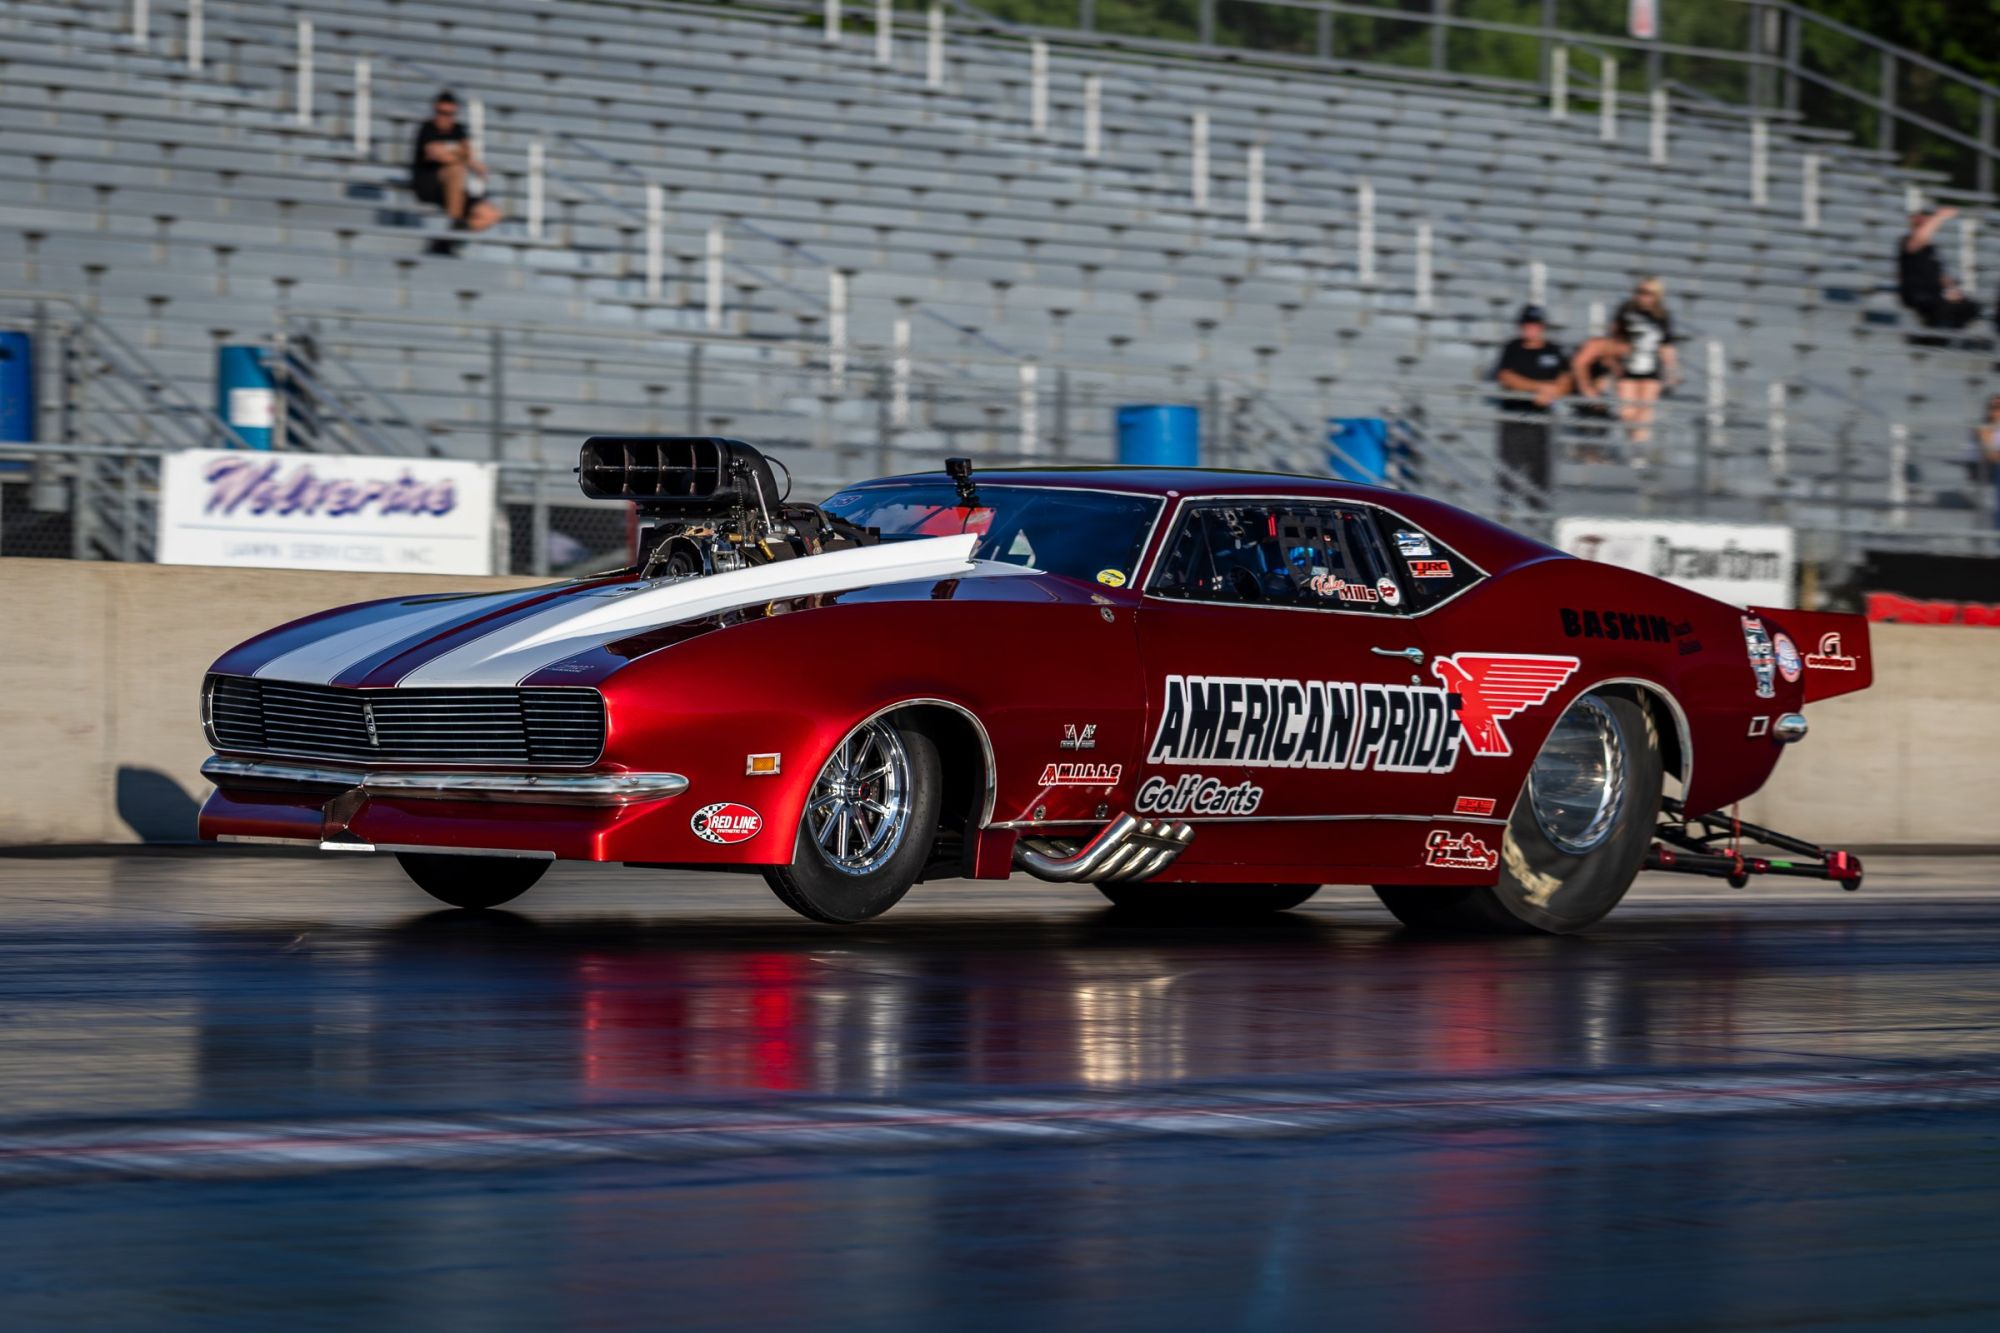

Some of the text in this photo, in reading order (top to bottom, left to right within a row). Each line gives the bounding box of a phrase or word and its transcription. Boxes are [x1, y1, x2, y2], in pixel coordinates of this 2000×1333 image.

[1340, 585, 1378, 602] Mills
[1560, 607, 1670, 643] BASKIN
[1150, 677, 1463, 771] AMERICAN PRIDE
[1136, 776, 1261, 814] Golf Carts
[711, 815, 758, 830] RED LINE
